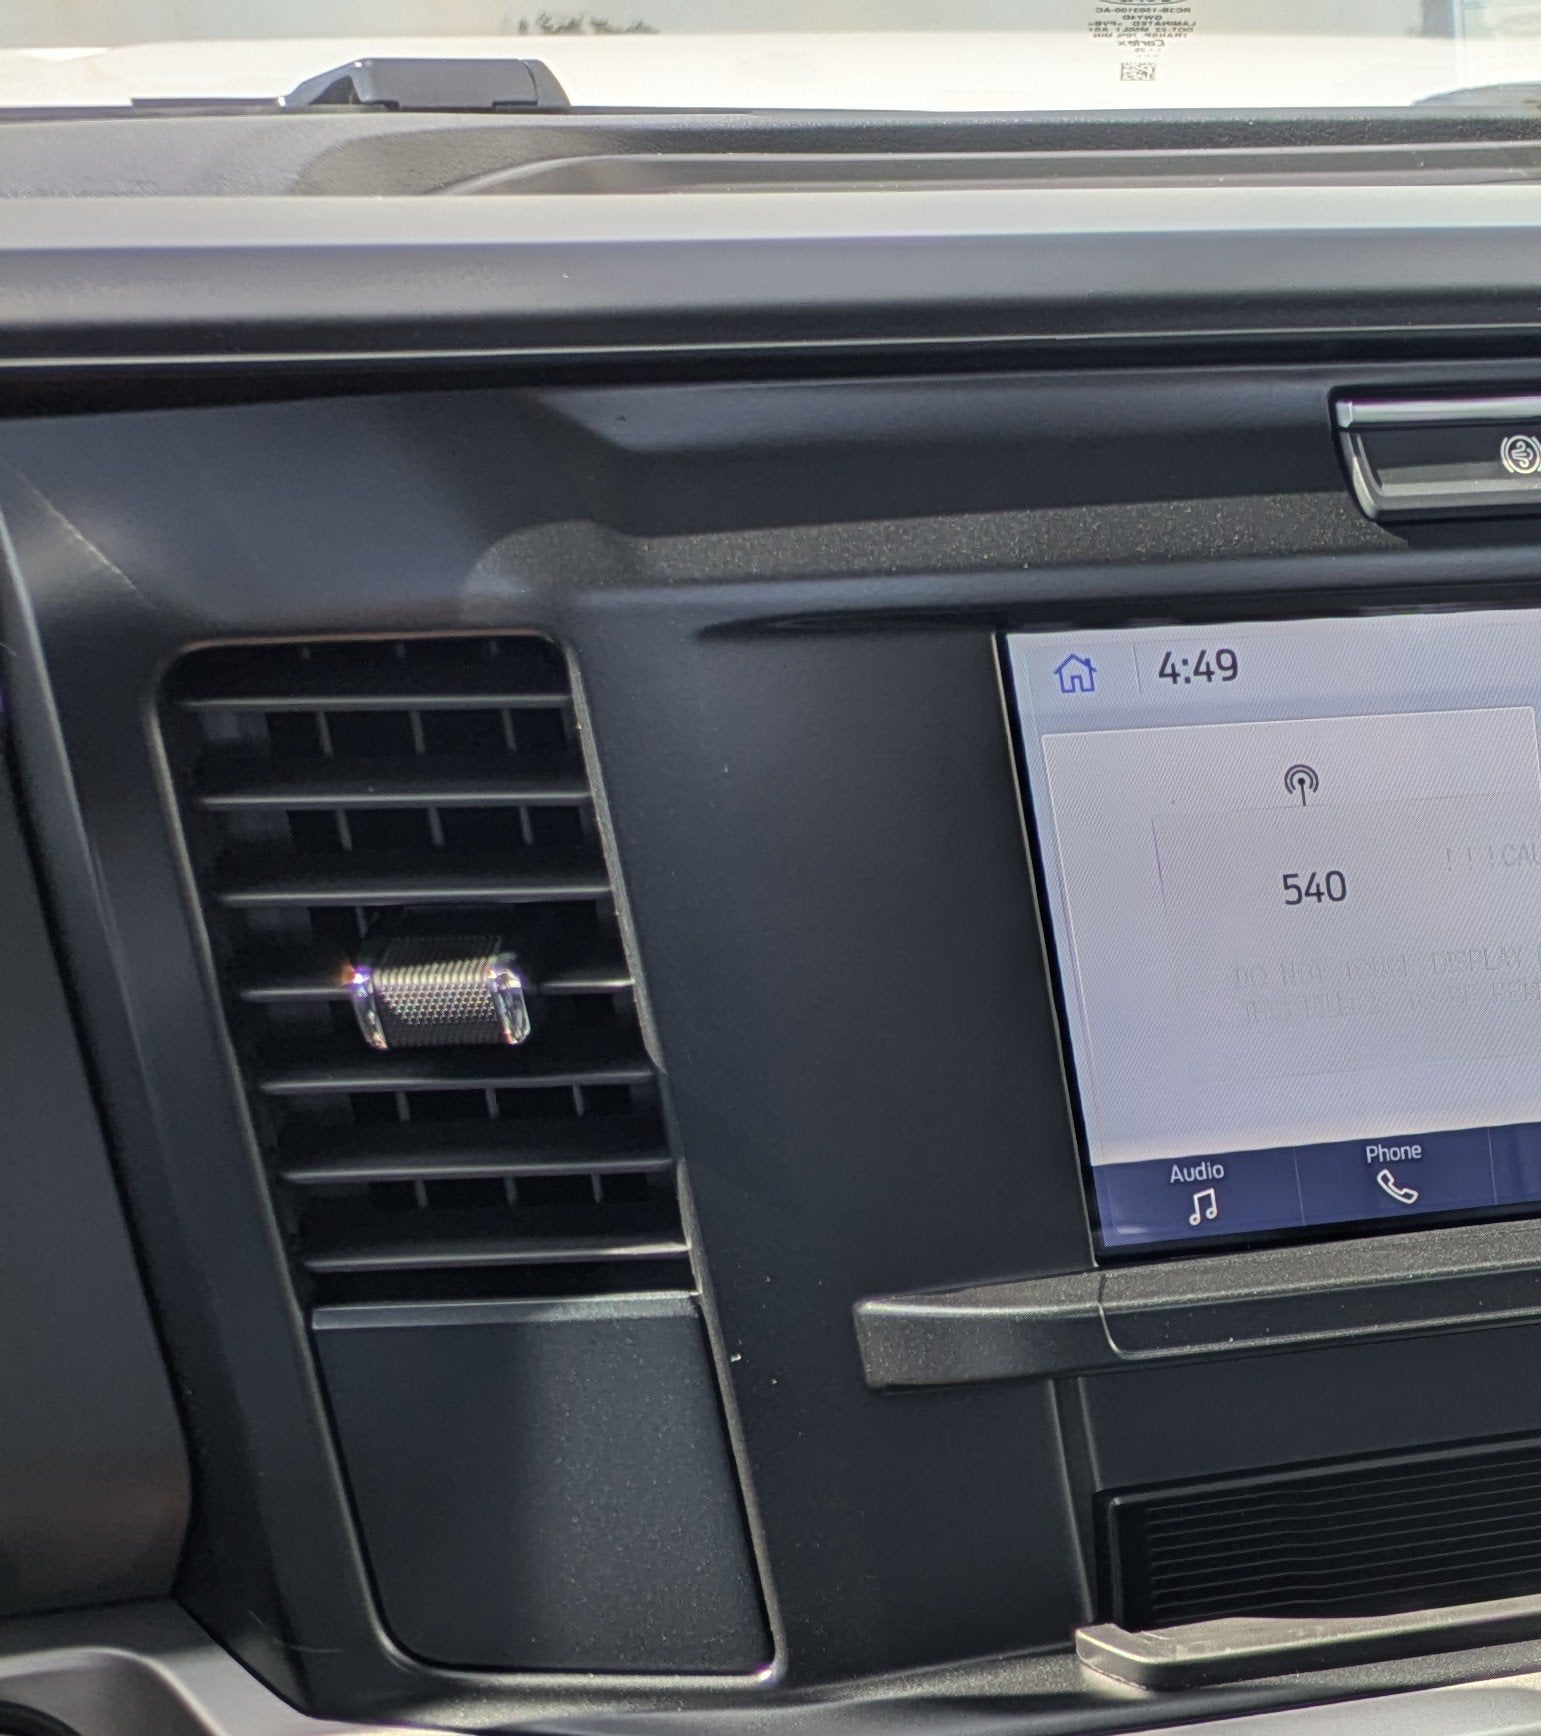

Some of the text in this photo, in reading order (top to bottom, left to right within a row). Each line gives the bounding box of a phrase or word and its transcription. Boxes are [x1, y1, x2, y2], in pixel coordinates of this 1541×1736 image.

[1158, 647, 1240, 688] 4:49
[1280, 869, 1349, 906] 540
[1364, 1141, 1423, 1165] Phone
[1169, 1160, 1226, 1185] Audio
